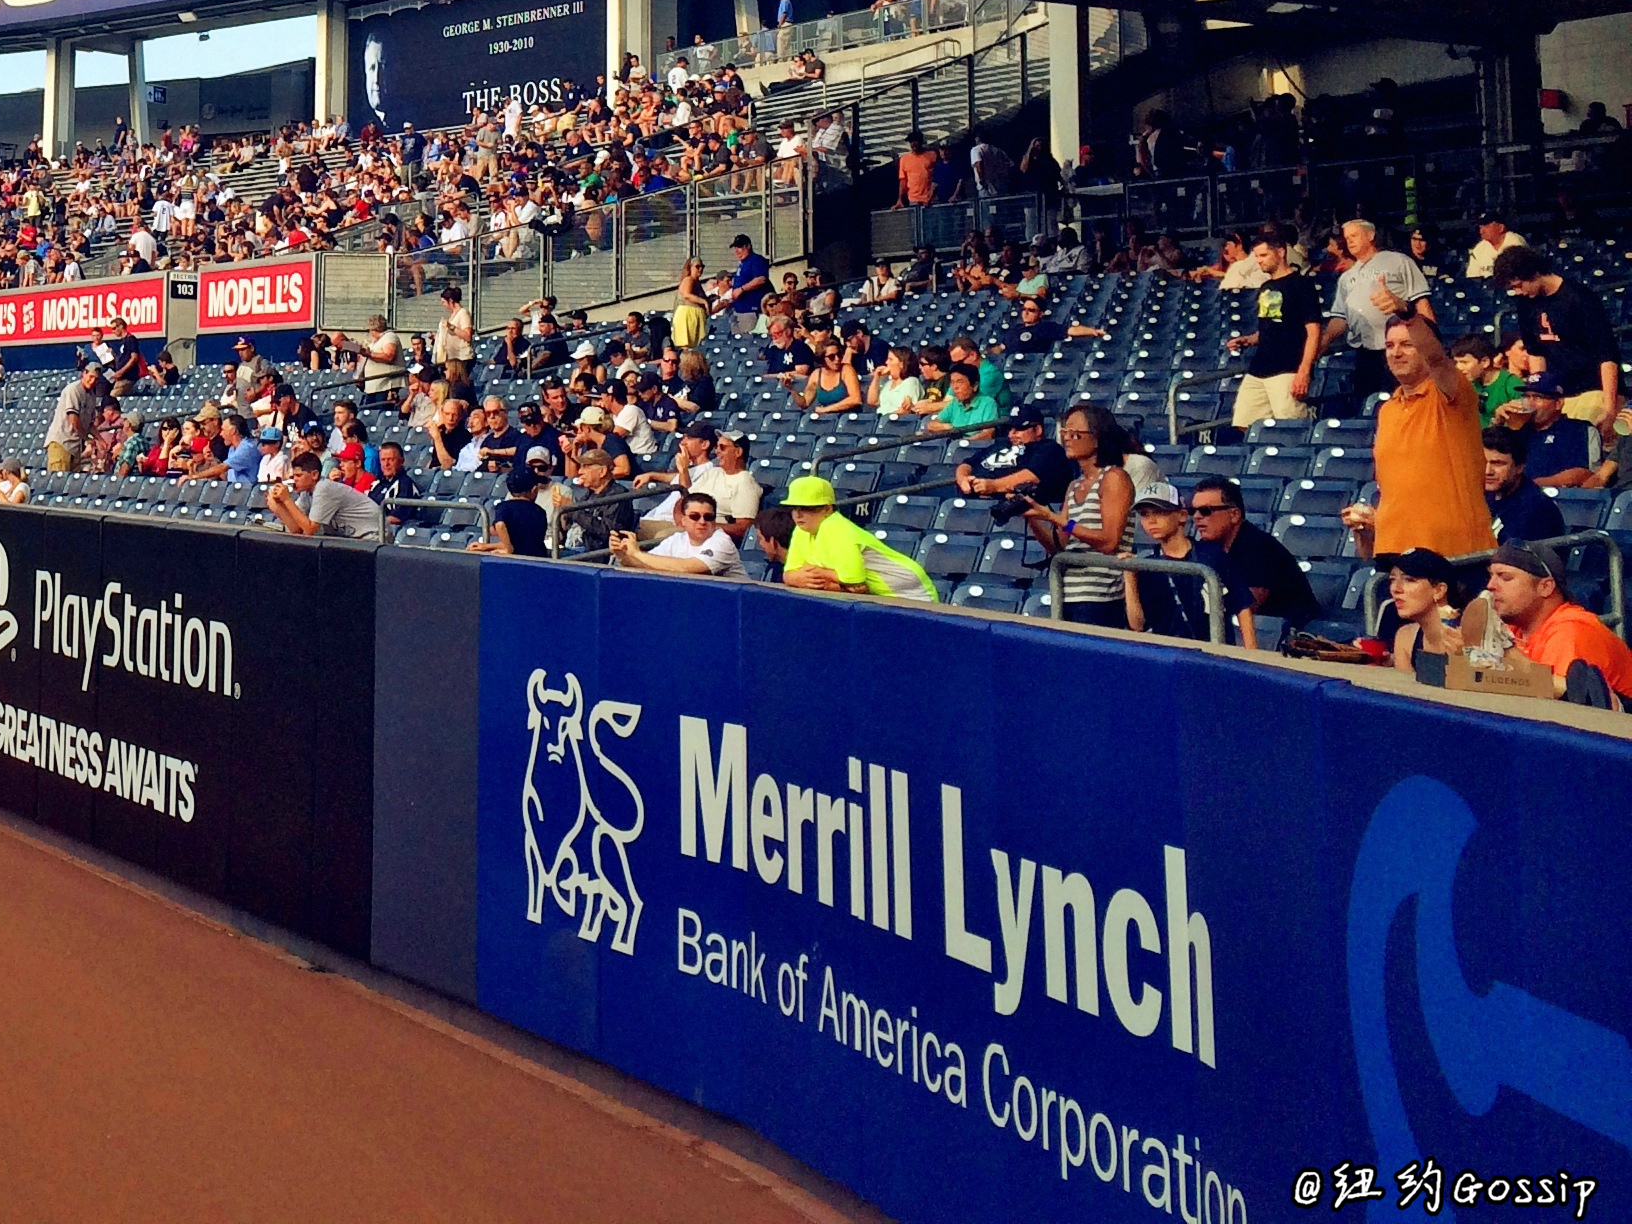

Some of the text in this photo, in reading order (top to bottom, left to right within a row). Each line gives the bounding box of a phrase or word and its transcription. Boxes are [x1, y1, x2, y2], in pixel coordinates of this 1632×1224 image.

[442, 1, 584, 38] GEORGE M. STEINBRENNER III
[488, 36, 534, 55] 1930-2010
[462, 78, 562, 114] THE BOSS
[176, 283, 194, 296] 103
[208, 272, 303, 318] MODELL'S
[42, 292, 157, 332] MODELLS.com
[33, 569, 233, 696] PlayStation
[104, 738, 196, 823] AWAITS
[680, 714, 1217, 1070] Merrill Lynch
[677, 907, 1247, 1224] Bank of America Corporation
